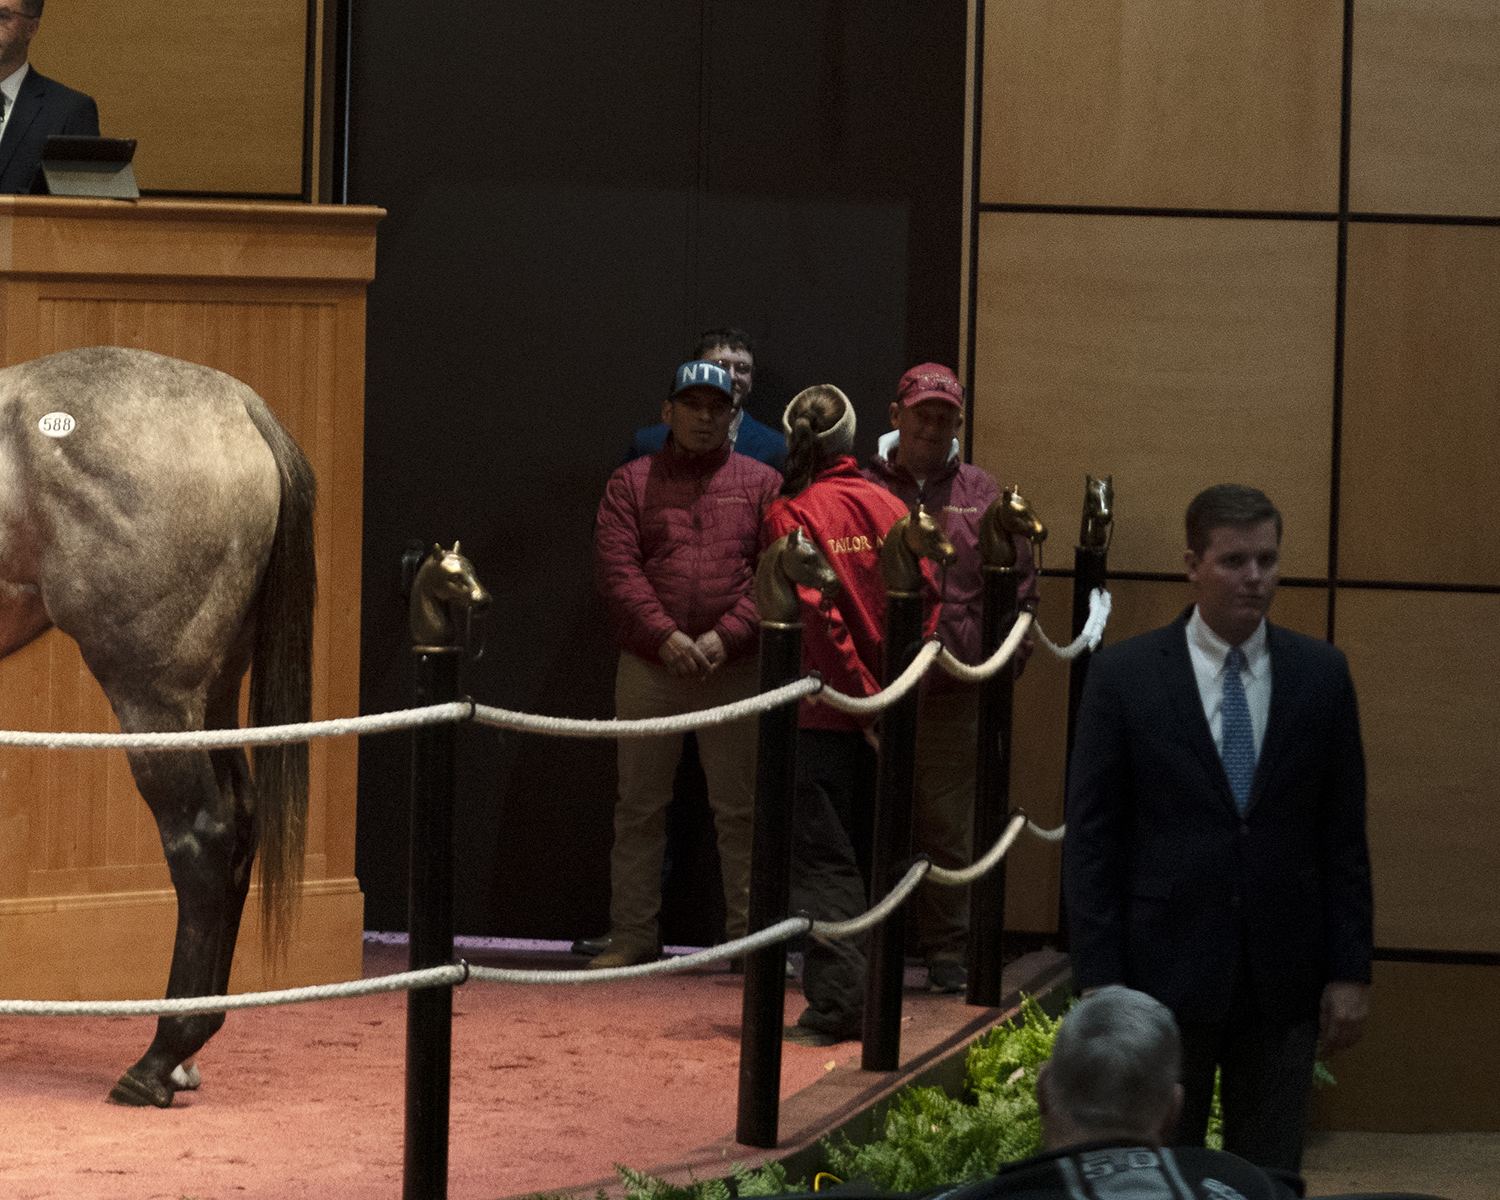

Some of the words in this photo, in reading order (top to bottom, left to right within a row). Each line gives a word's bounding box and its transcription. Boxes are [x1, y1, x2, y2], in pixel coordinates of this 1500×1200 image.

[681, 362, 727, 385] NTT
[43, 417, 71, 432] 588
[826, 535, 872, 555] TAYLOR
